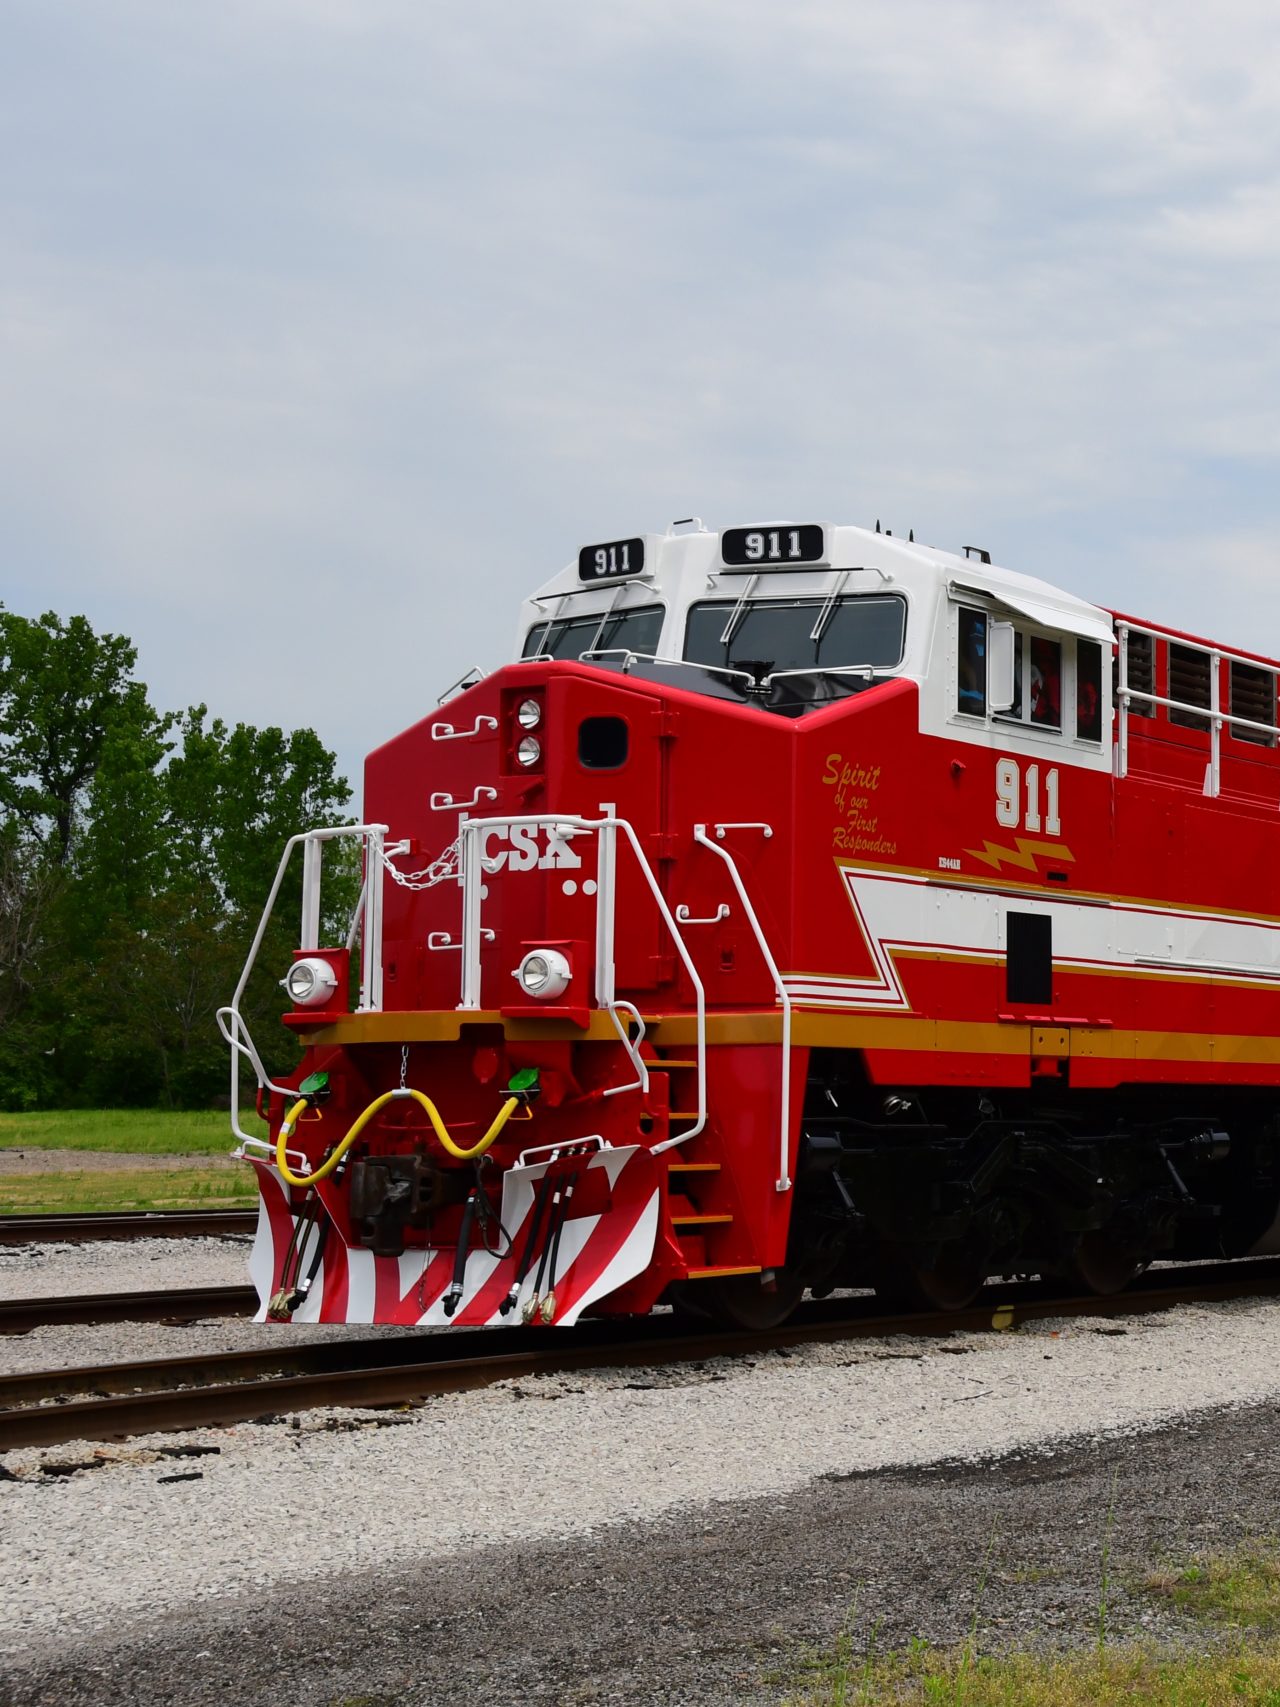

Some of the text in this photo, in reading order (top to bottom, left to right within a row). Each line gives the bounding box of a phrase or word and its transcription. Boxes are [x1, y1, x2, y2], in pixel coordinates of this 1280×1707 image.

[595, 544, 630, 574] 911
[745, 530, 801, 559] 911
[822, 753, 881, 792] Spirit
[834, 788, 869, 813] of our
[995, 757, 1061, 836] 911
[847, 809, 878, 834] First
[480, 814, 582, 874] CSX
[832, 826, 897, 856] Responders
